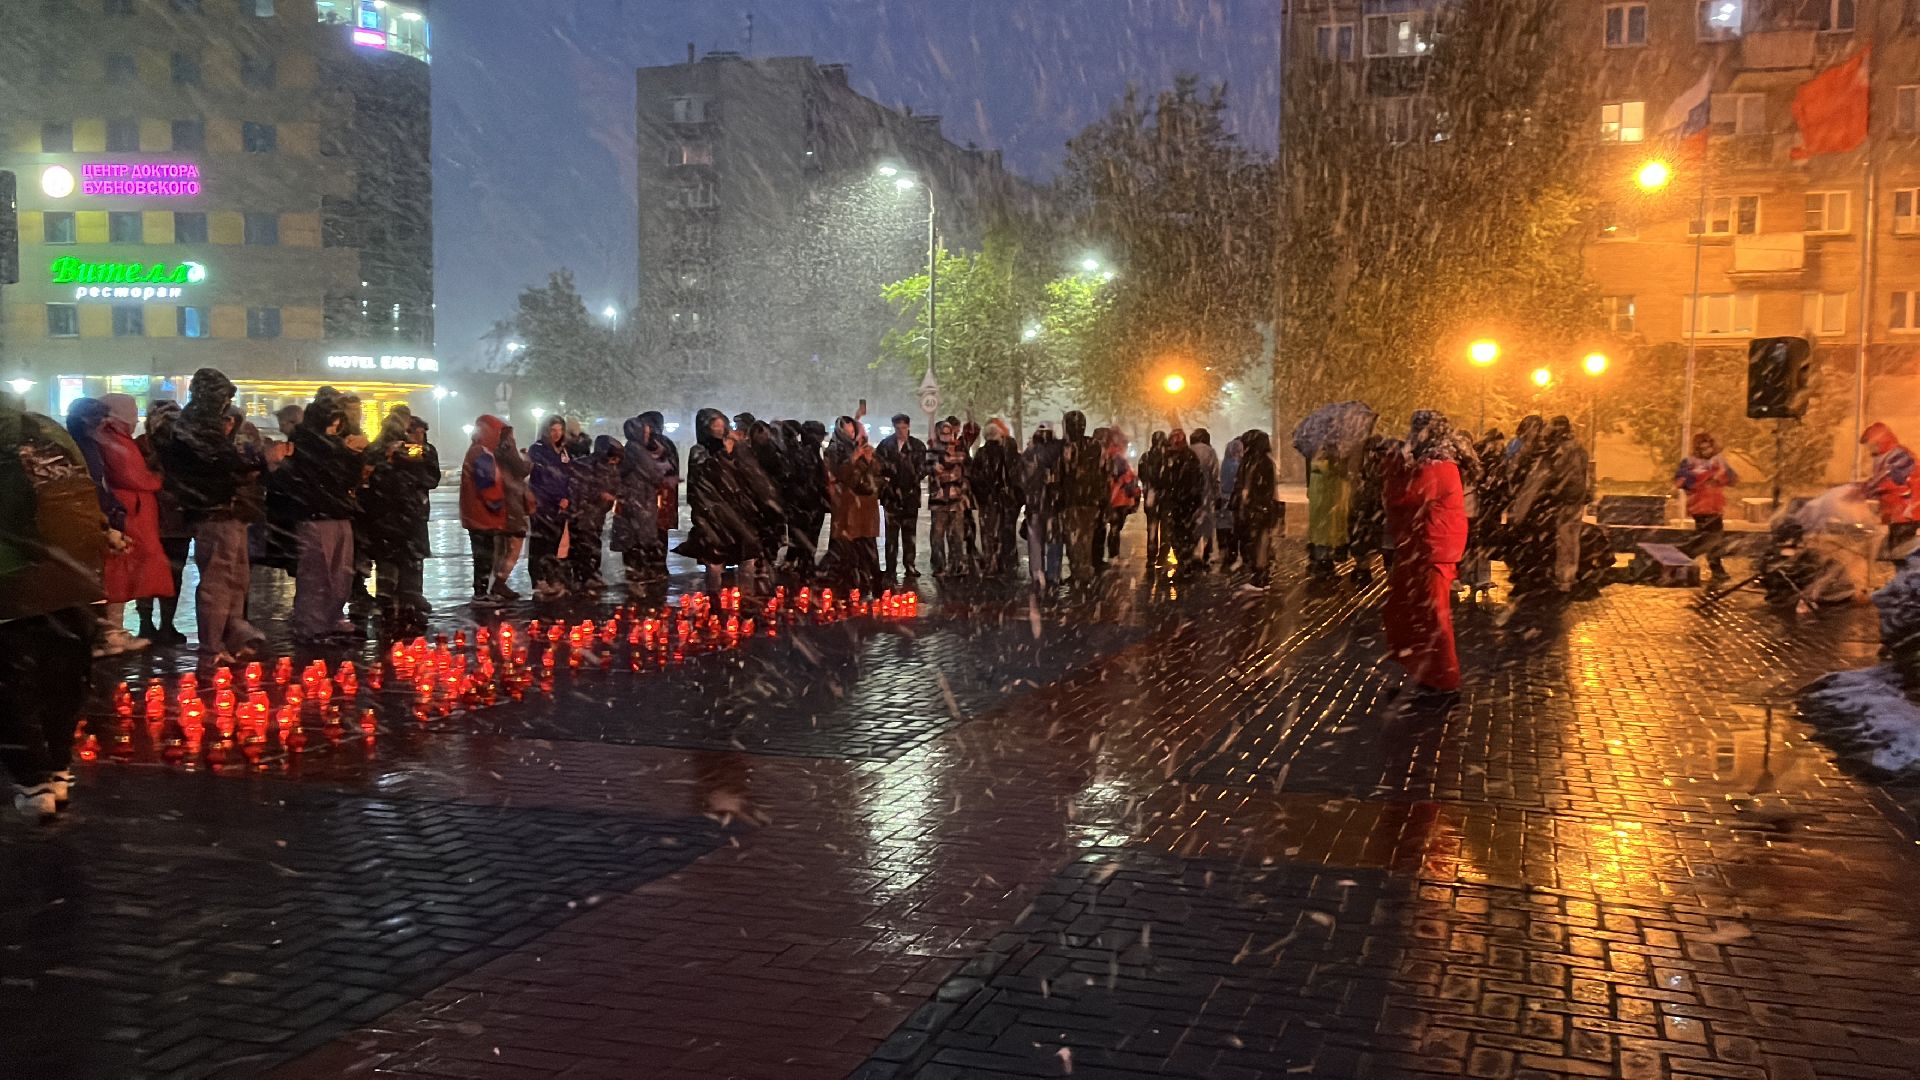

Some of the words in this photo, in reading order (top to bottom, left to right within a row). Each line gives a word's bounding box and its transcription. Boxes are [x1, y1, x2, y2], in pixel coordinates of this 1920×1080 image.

[82, 164, 129, 178] ЦЕНТР
[131, 164, 200, 178] ДОКТОРА
[82, 180, 200, 195] БУБНОВСКОГО
[76, 286, 182, 300] ресторан
[327, 355, 377, 369] HOTEL
[380, 355, 416, 370] EAST
